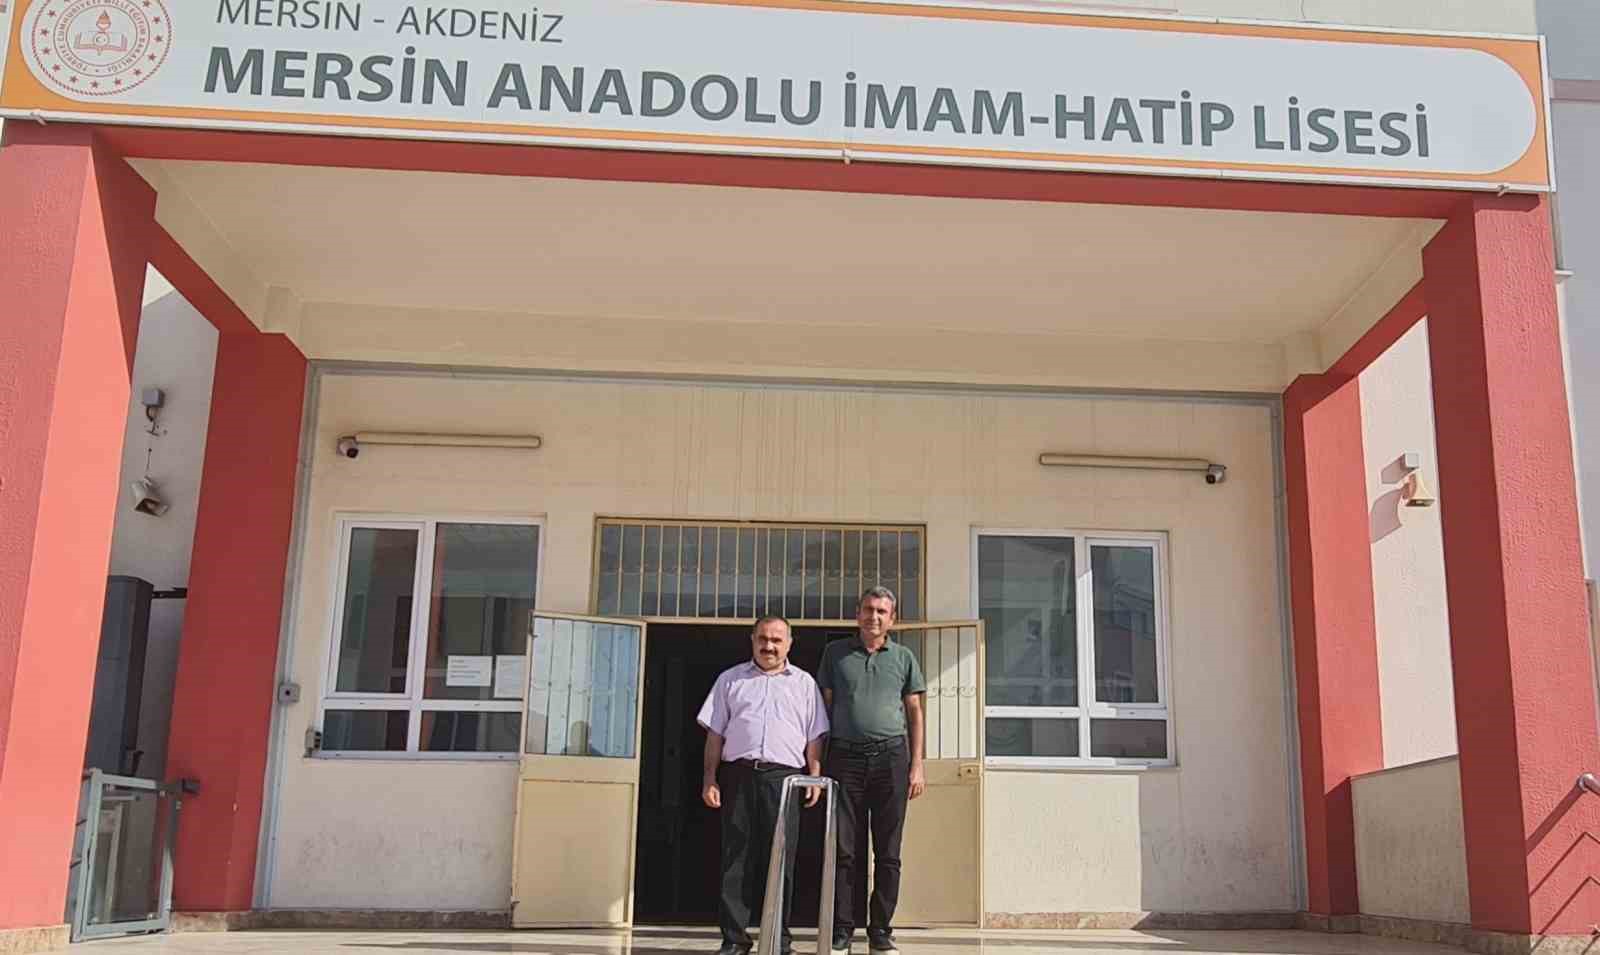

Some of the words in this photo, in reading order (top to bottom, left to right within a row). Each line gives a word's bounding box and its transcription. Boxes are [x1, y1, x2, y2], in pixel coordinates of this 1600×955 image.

[395, 6, 564, 43] AKDENİZ
[203, 45, 468, 107] MERSİN
[486, 62, 822, 126] ANADOLU
[844, 71, 1235, 147] İMAM-HATİP
[1253, 95, 1429, 158] LİSESİ
